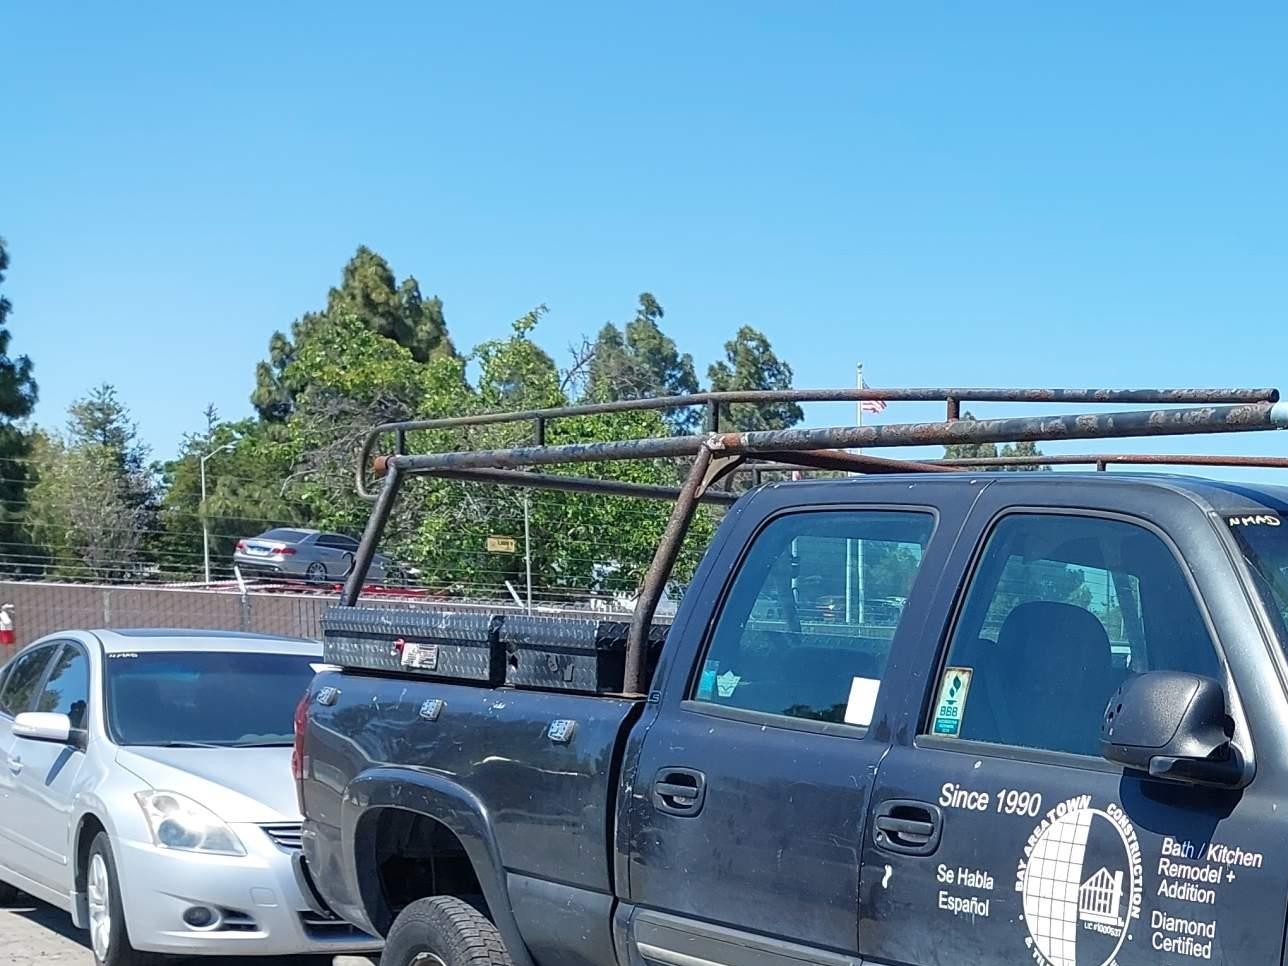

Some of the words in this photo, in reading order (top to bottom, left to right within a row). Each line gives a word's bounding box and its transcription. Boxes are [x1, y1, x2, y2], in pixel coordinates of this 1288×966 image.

[939, 782, 989, 811] Since
[997, 789, 1042, 817] 1990
[1015, 859, 1028, 891] BAY
[1023, 819, 1051, 857] AREA
[1047, 794, 1092, 824] TOWN
[1106, 803, 1143, 919] CONSTRUCTION
[1162, 837, 1194, 859] Bath
[1197, 842, 1206, 859] /
[1207, 843, 1263, 868] Kitchen
[937, 864, 954, 883] Se
[957, 867, 994, 890] Habla
[1157, 857, 1223, 884] Remodel
[1226, 870, 1236, 883] +
[938, 890, 989, 917] Español
[1157, 879, 1216, 904] Addition
[1151, 910, 1216, 938] Diamond
[1024, 936, 1033, 949] &
[1152, 931, 1212, 960] Certified
